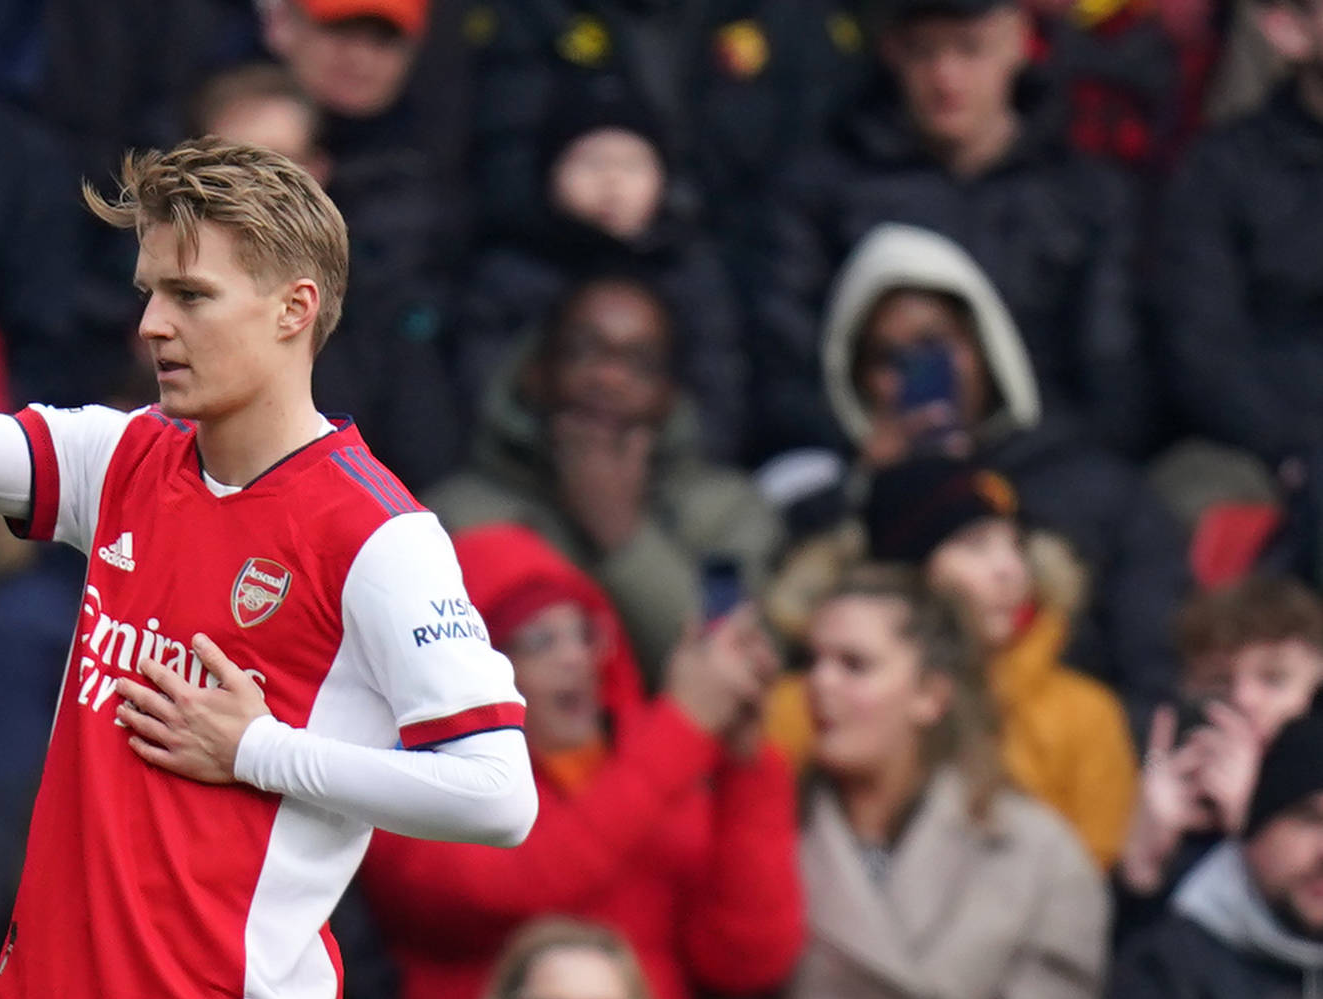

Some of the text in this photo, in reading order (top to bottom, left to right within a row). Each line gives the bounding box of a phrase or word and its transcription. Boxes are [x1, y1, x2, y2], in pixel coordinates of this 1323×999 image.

[98, 546, 136, 572] adidas
[246, 566, 285, 589] Arsenal
[412, 620, 487, 648] RWAND
